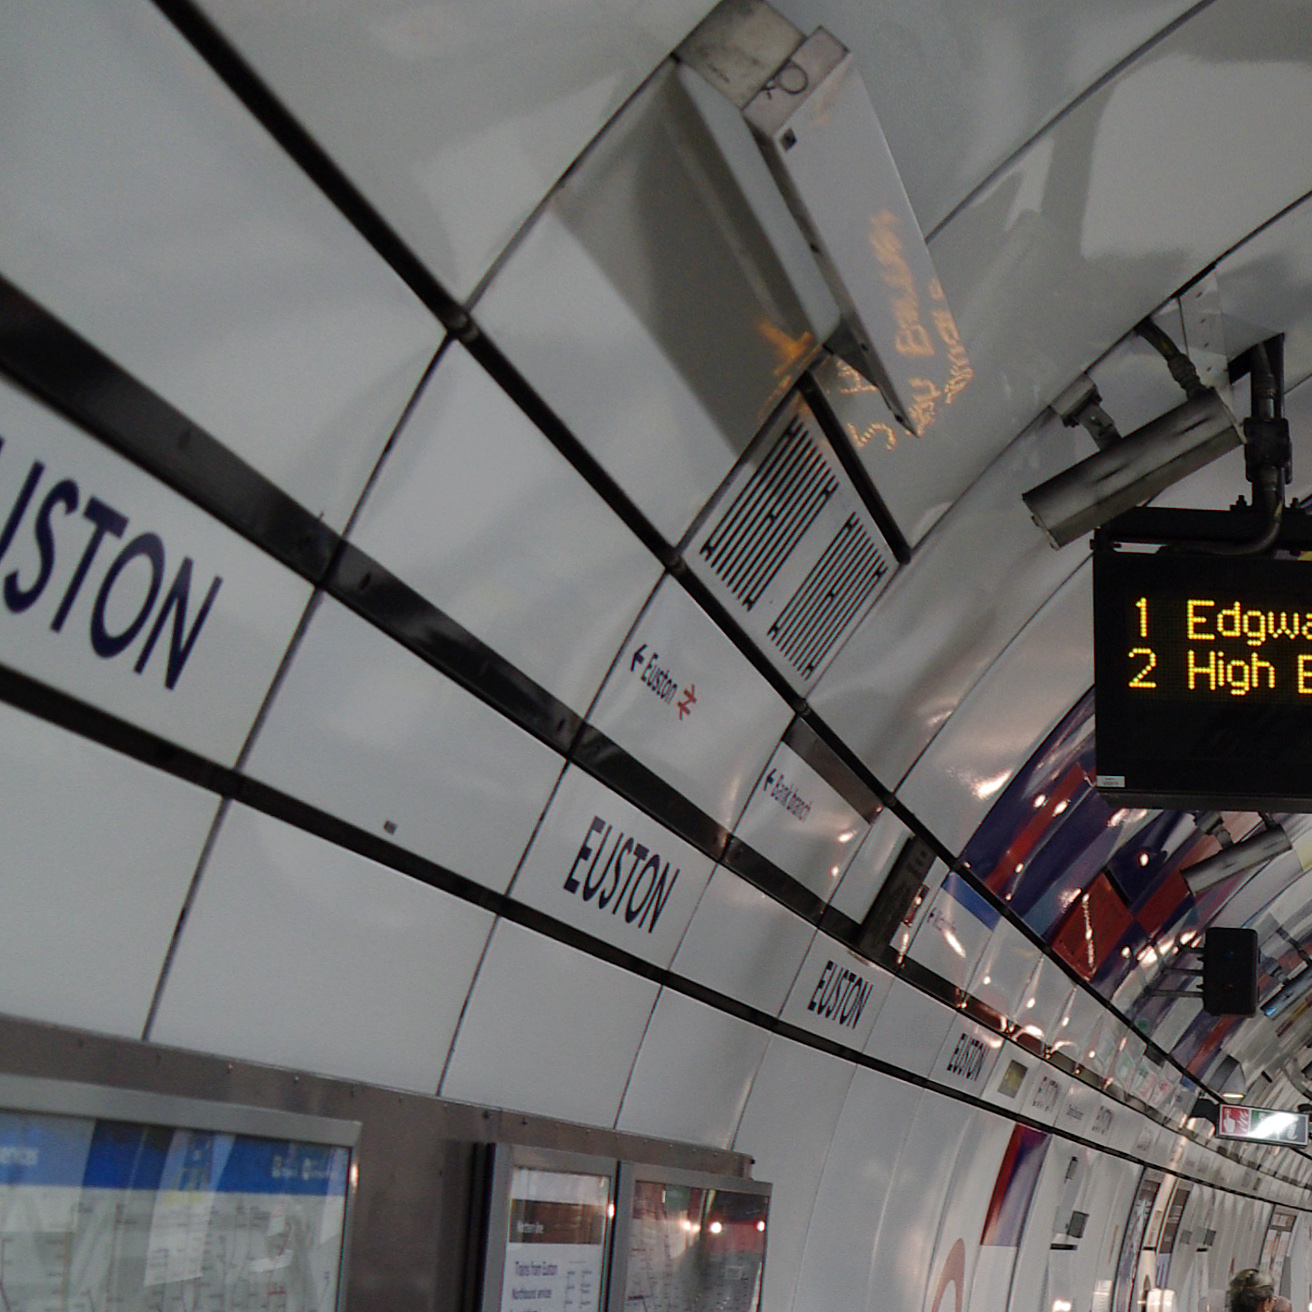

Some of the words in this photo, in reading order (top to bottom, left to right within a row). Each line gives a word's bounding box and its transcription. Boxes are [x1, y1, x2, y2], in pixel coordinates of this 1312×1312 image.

[0, 437, 223, 691] STON
[1136, 598, 1147, 637] 1
[640, 652, 678, 705] Euston
[1128, 648, 1157, 688] 2
[1187, 650, 1275, 696] High
[563, 815, 681, 934] EUSTON
[806, 959, 874, 1030] EUSTON
